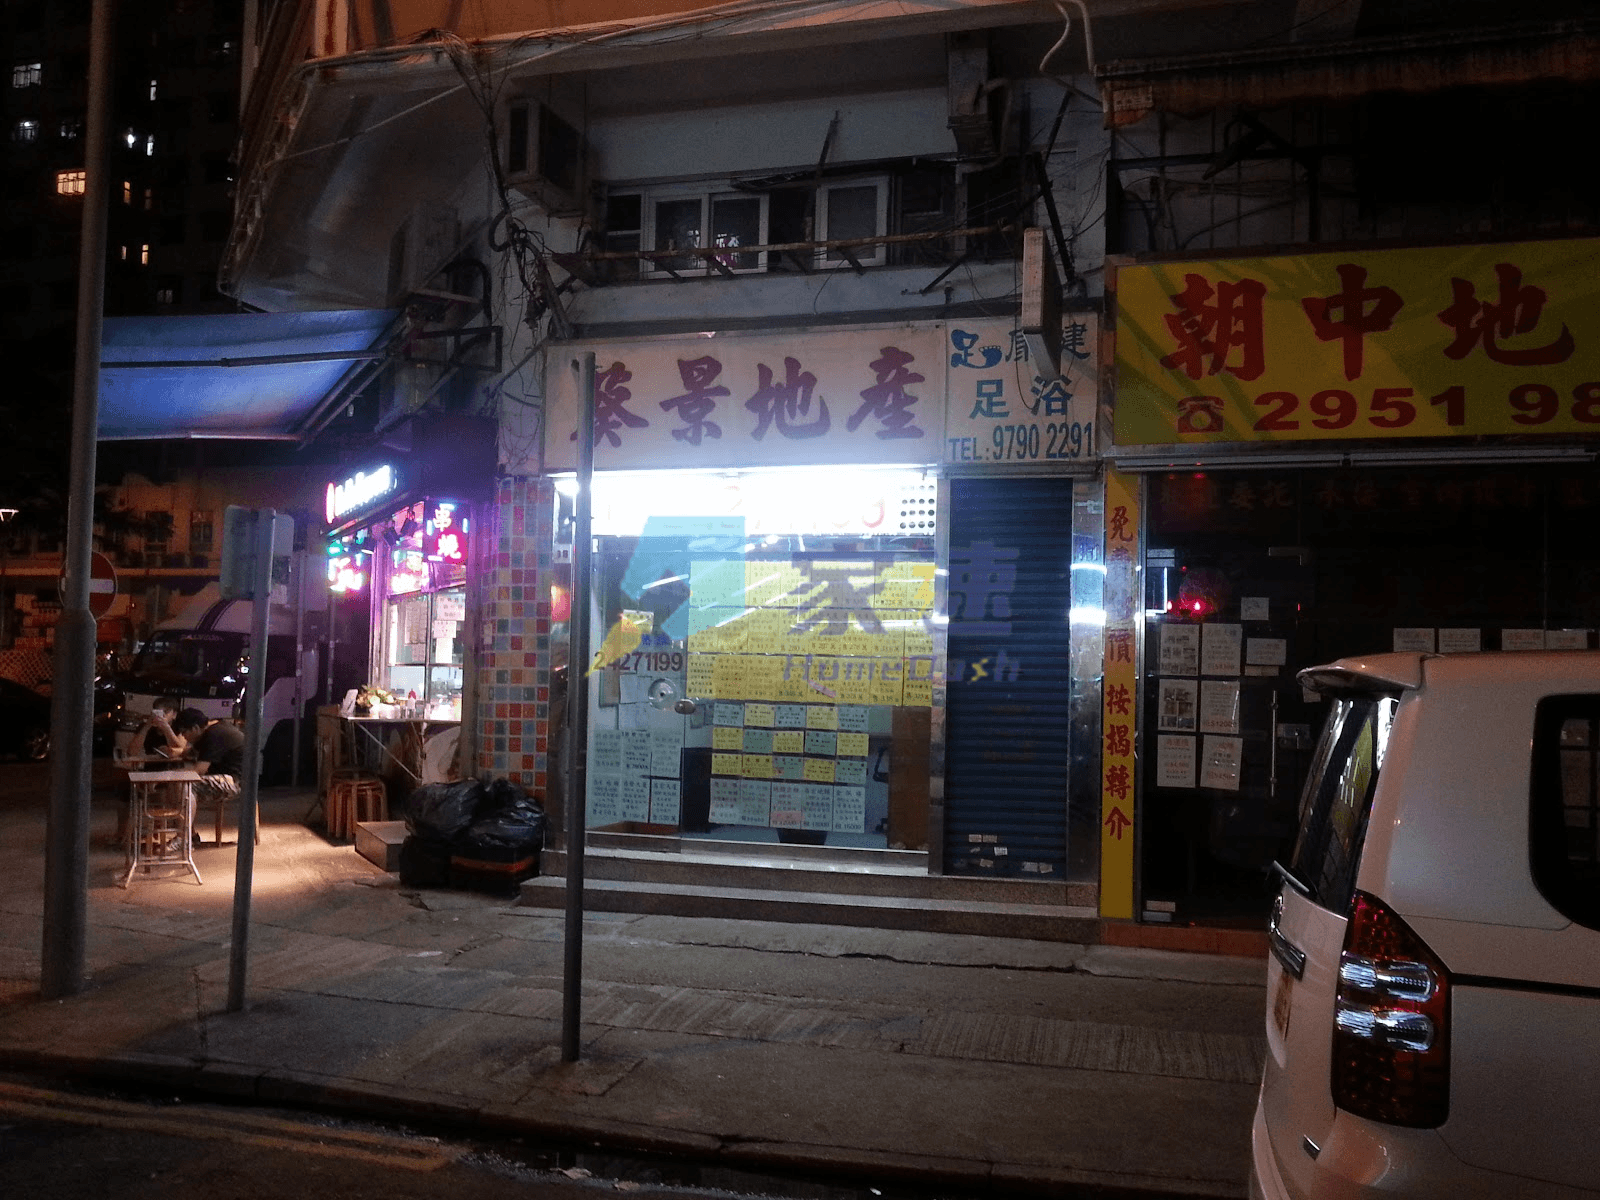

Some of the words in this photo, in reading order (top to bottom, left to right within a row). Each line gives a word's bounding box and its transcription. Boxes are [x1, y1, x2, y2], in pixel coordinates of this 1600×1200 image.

[1160, 263, 1575, 382] 朝中地
[969, 374, 1073, 420] 足浴
[1253, 386, 1465, 432] 2951
[992, 423, 1040, 460] 9790
[1046, 421, 1092, 459] 2291
[594, 651, 684, 672] 24271199
[1104, 682, 1133, 841] 按揭轉介
